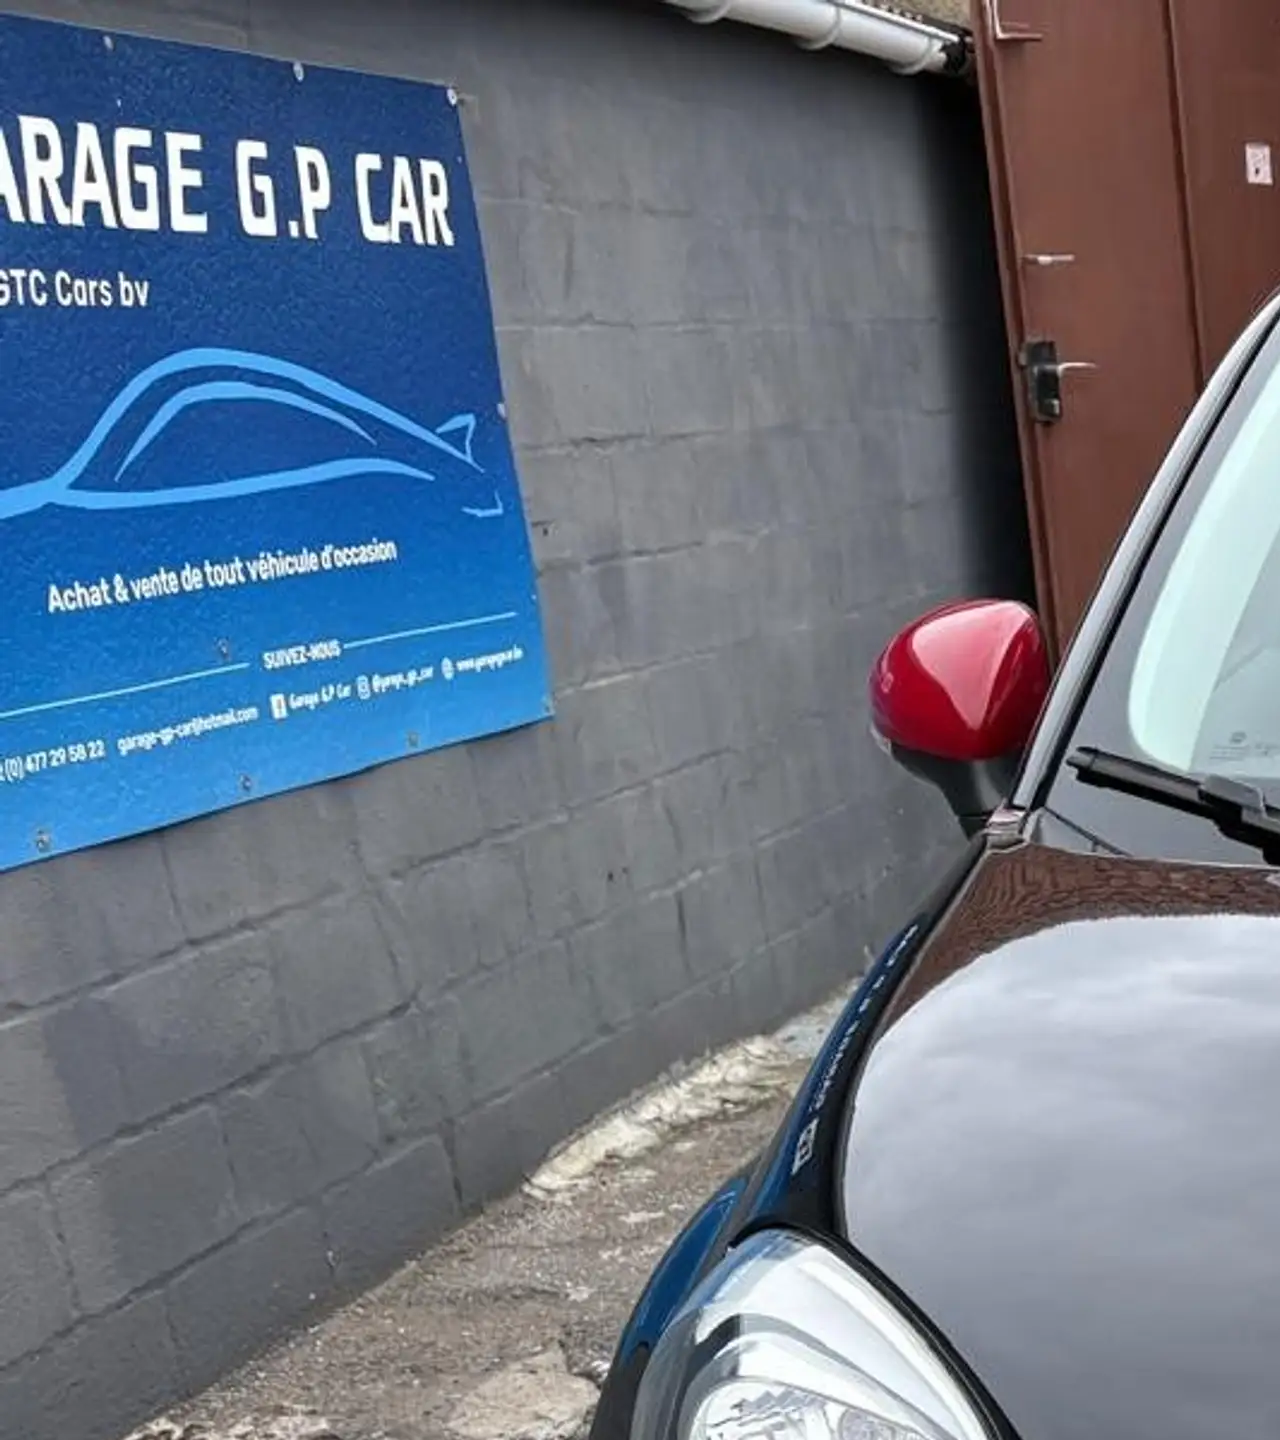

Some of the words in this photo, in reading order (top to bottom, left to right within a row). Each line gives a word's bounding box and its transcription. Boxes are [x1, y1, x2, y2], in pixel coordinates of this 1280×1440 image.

[235, 138, 332, 240] G.P
[354, 152, 455, 247] CAR
[54, 269, 113, 309] Cars
[117, 271, 150, 308] bv
[48, 577, 113, 614] Achat
[113, 574, 131, 603] &
[131, 567, 180, 601] vente
[180, 562, 203, 592] de
[203, 556, 246, 589] tout
[249, 547, 320, 582] véhicule
[321, 537, 398, 570] d'occasion
[263, 638, 342, 671] SUIVEZ-NOUS
[86, 739, 106, 759] 22
